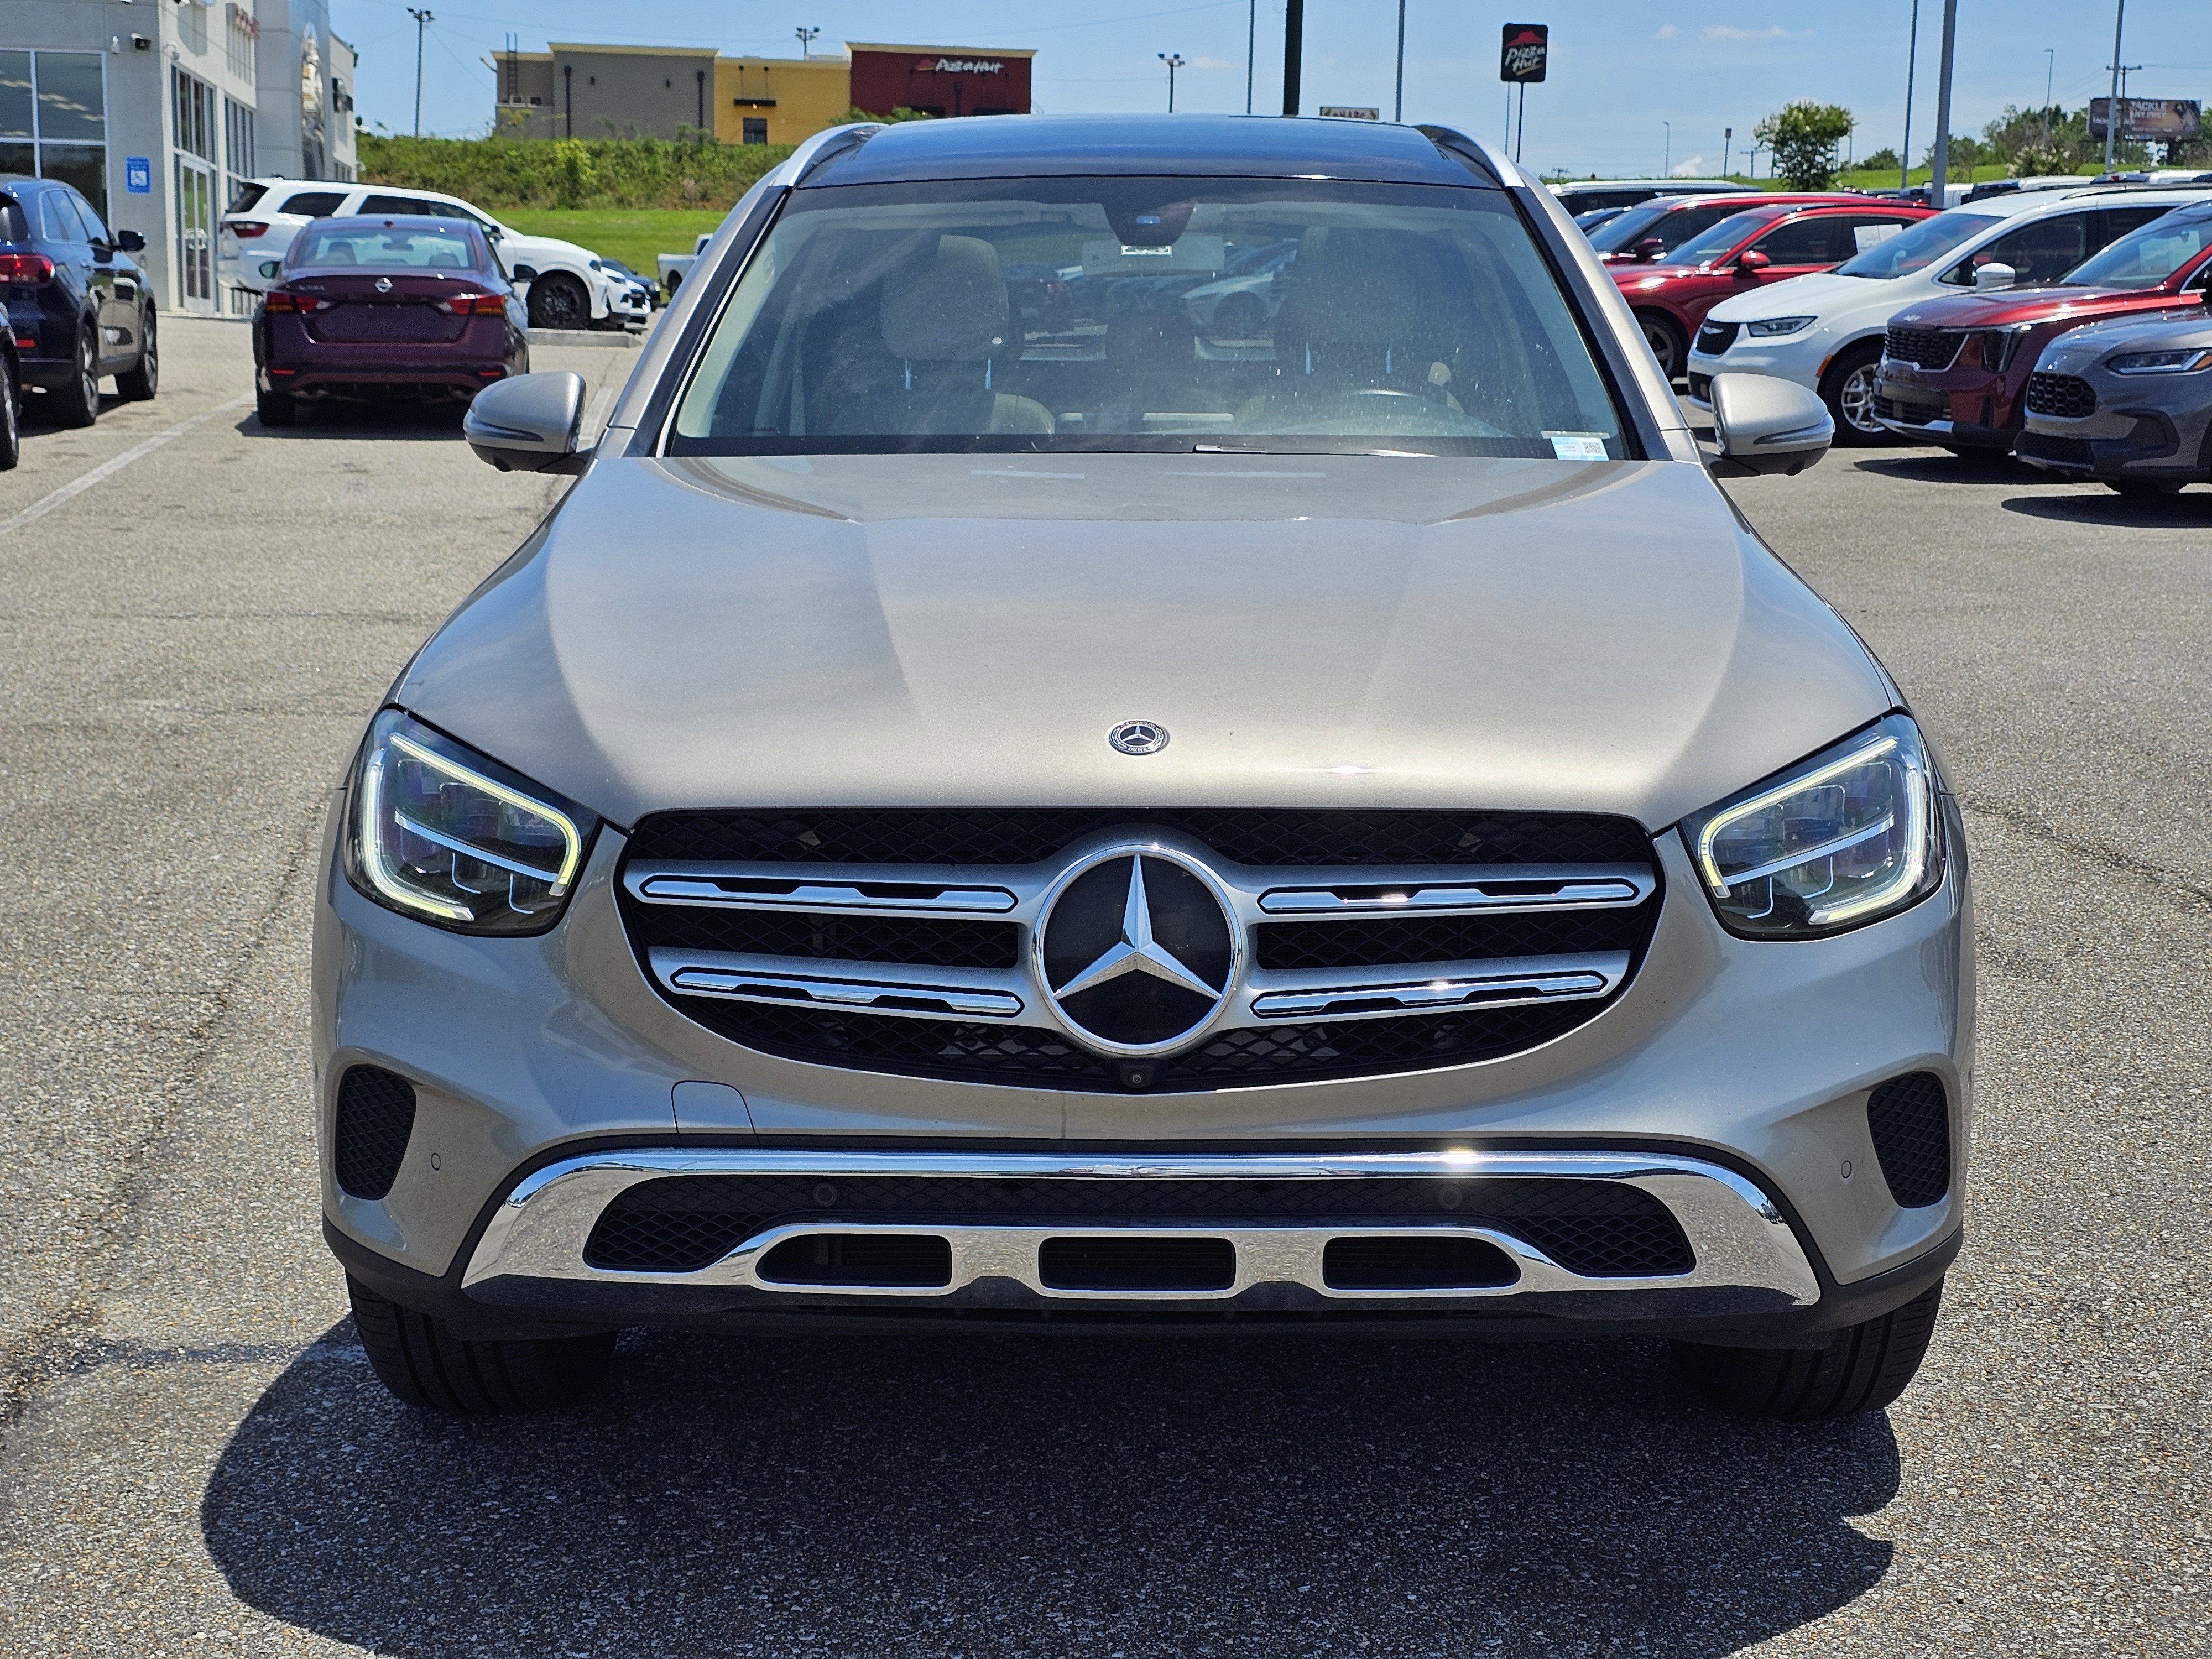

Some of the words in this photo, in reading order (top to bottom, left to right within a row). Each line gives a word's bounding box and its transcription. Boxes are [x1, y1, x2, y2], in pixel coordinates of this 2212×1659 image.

[1505, 45, 1545, 67] Pizza
[1512, 54, 1541, 72] Hut
[935, 58, 974, 72] Pizza
[973, 59, 1005, 75] Hut
